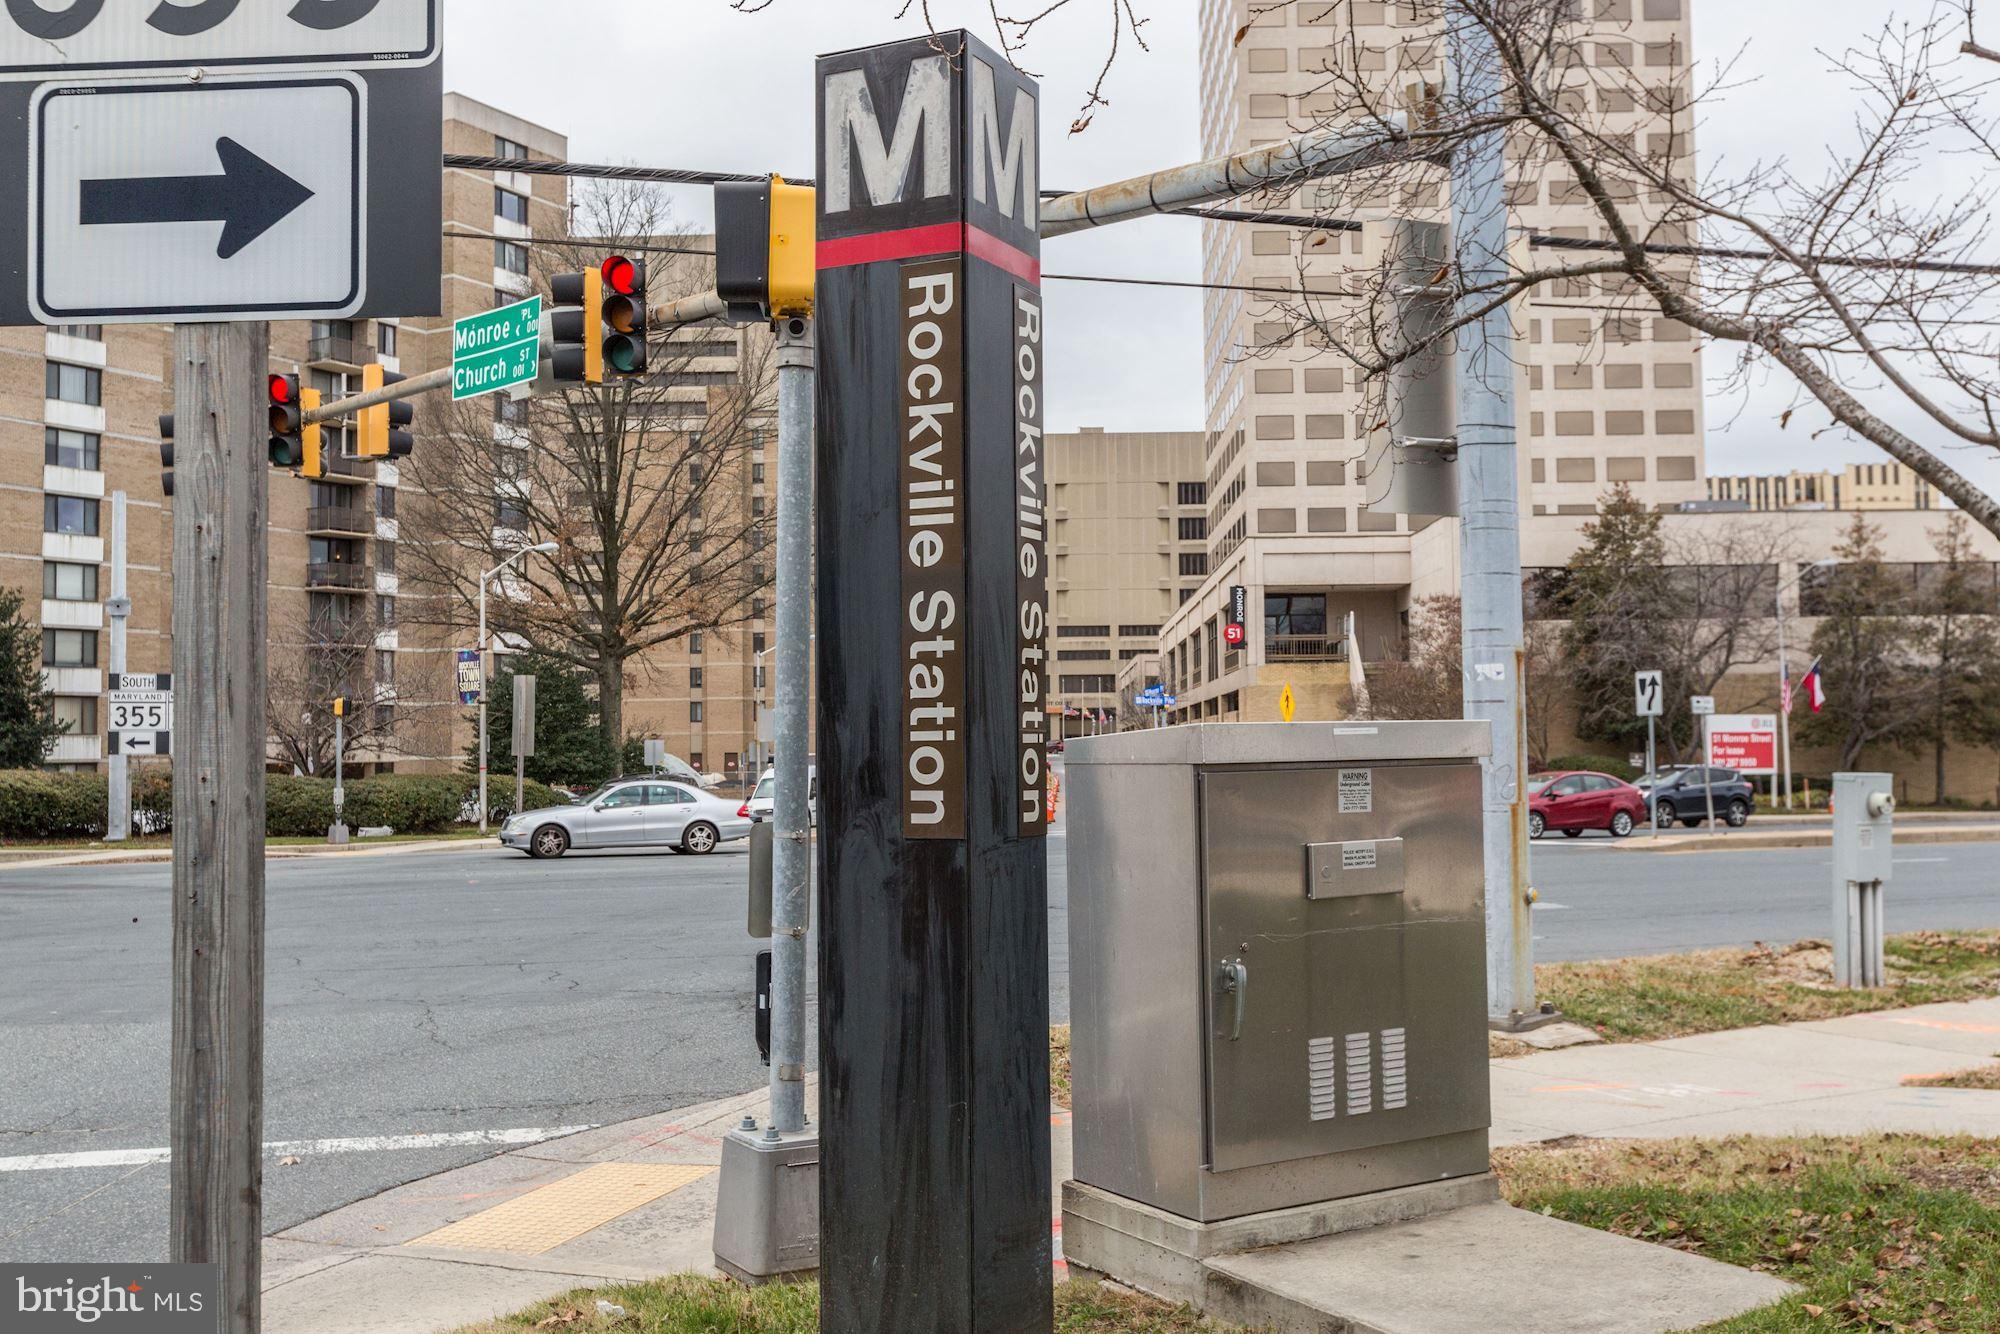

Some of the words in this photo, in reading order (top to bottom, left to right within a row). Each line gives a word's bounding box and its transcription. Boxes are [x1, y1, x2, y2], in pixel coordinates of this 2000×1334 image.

[825, 55, 950, 214] M
[973, 55, 1036, 232] M
[456, 321, 510, 351] Monroe
[521, 307, 533, 321] PL
[455, 358, 507, 390] Church
[520, 347, 531, 361] ST
[908, 272, 954, 567] Rockville
[1018, 298, 1043, 578] Rockville
[1236, 588, 1244, 622] MONROE
[1228, 628, 1240, 638] 51
[122, 676, 155, 688] SOUTH
[459, 669, 480, 682] TOWN
[115, 706, 161, 727] 355
[908, 590, 956, 824] Station
[1020, 600, 1044, 823] Station
[1713, 746, 1725, 755] For
[1342, 772, 1367, 780] WARNING
